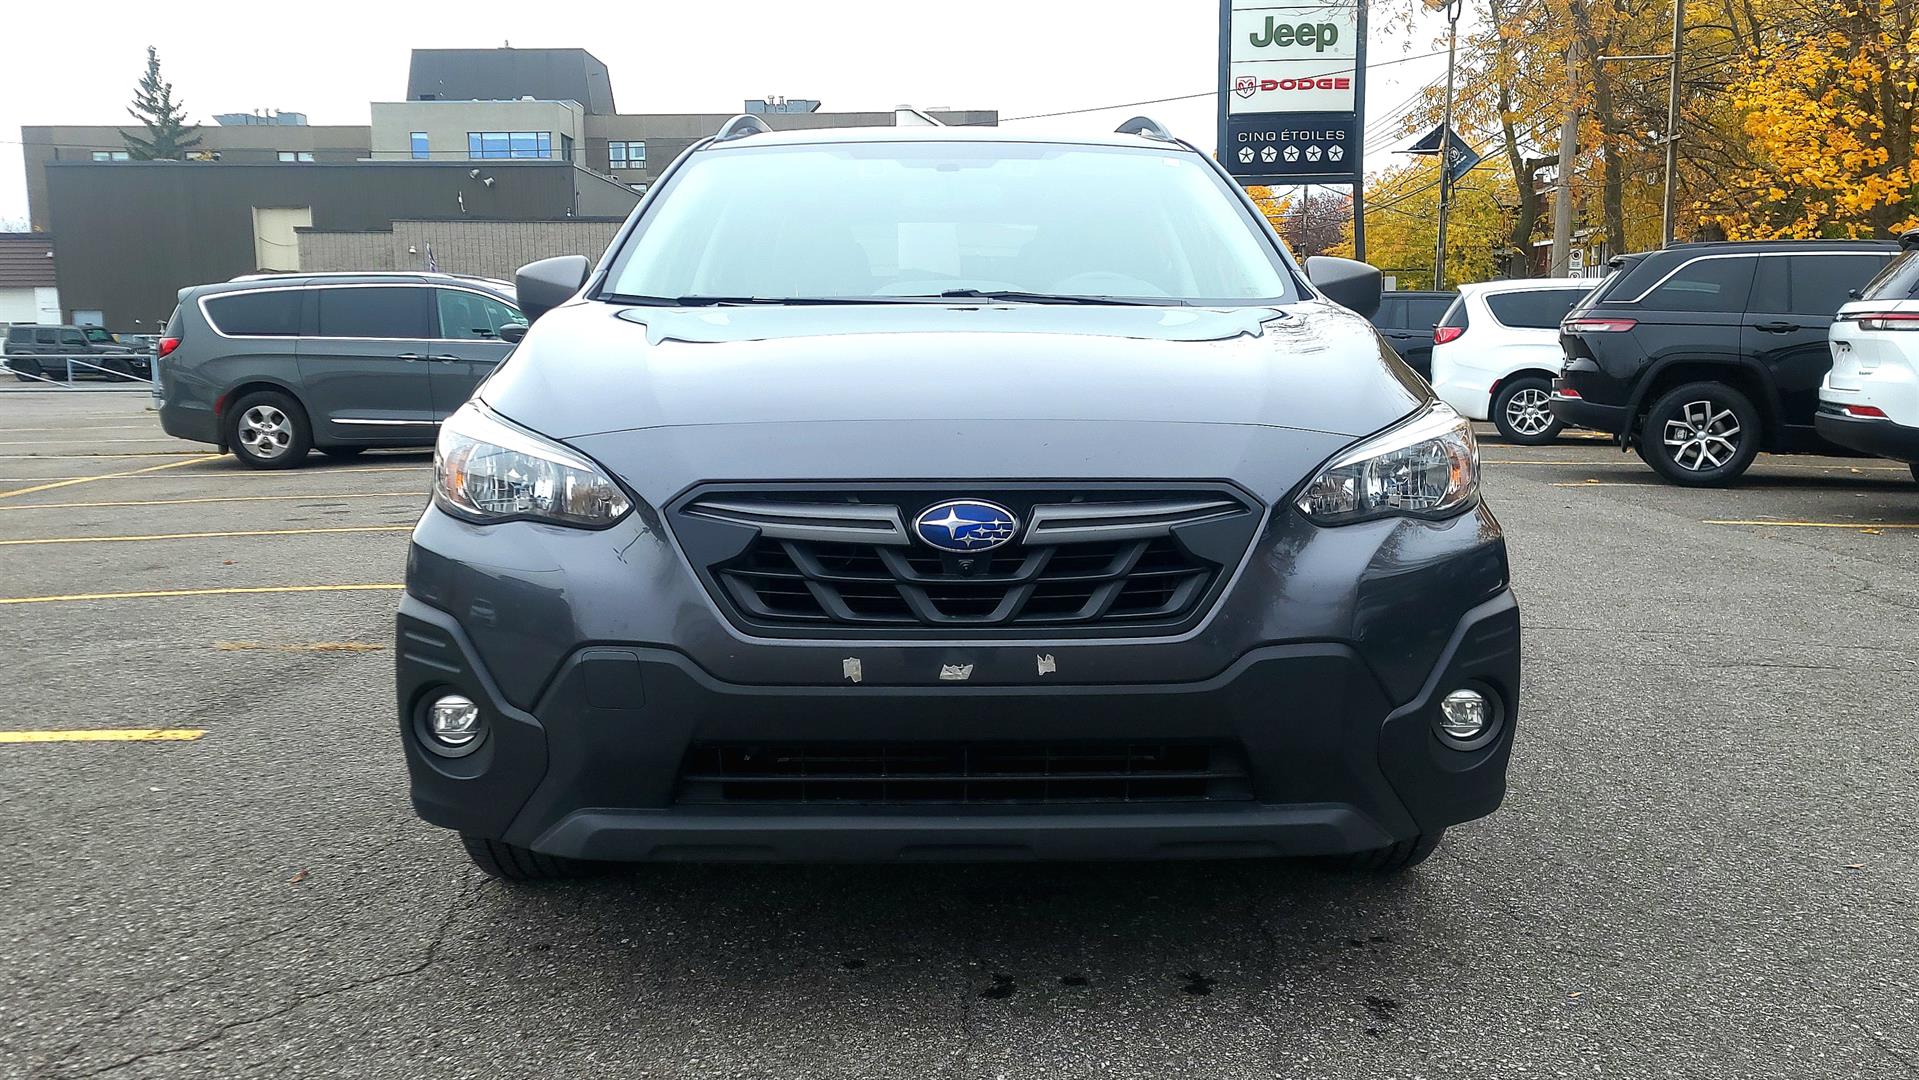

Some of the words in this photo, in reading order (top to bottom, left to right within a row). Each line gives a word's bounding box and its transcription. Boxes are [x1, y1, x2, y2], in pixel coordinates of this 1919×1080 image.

[1249, 16, 1339, 52] Jeep
[1260, 78, 1350, 91] DODGE
[1238, 131, 1276, 142] CINQ
[1281, 129, 1345, 140] ÉTOILES
